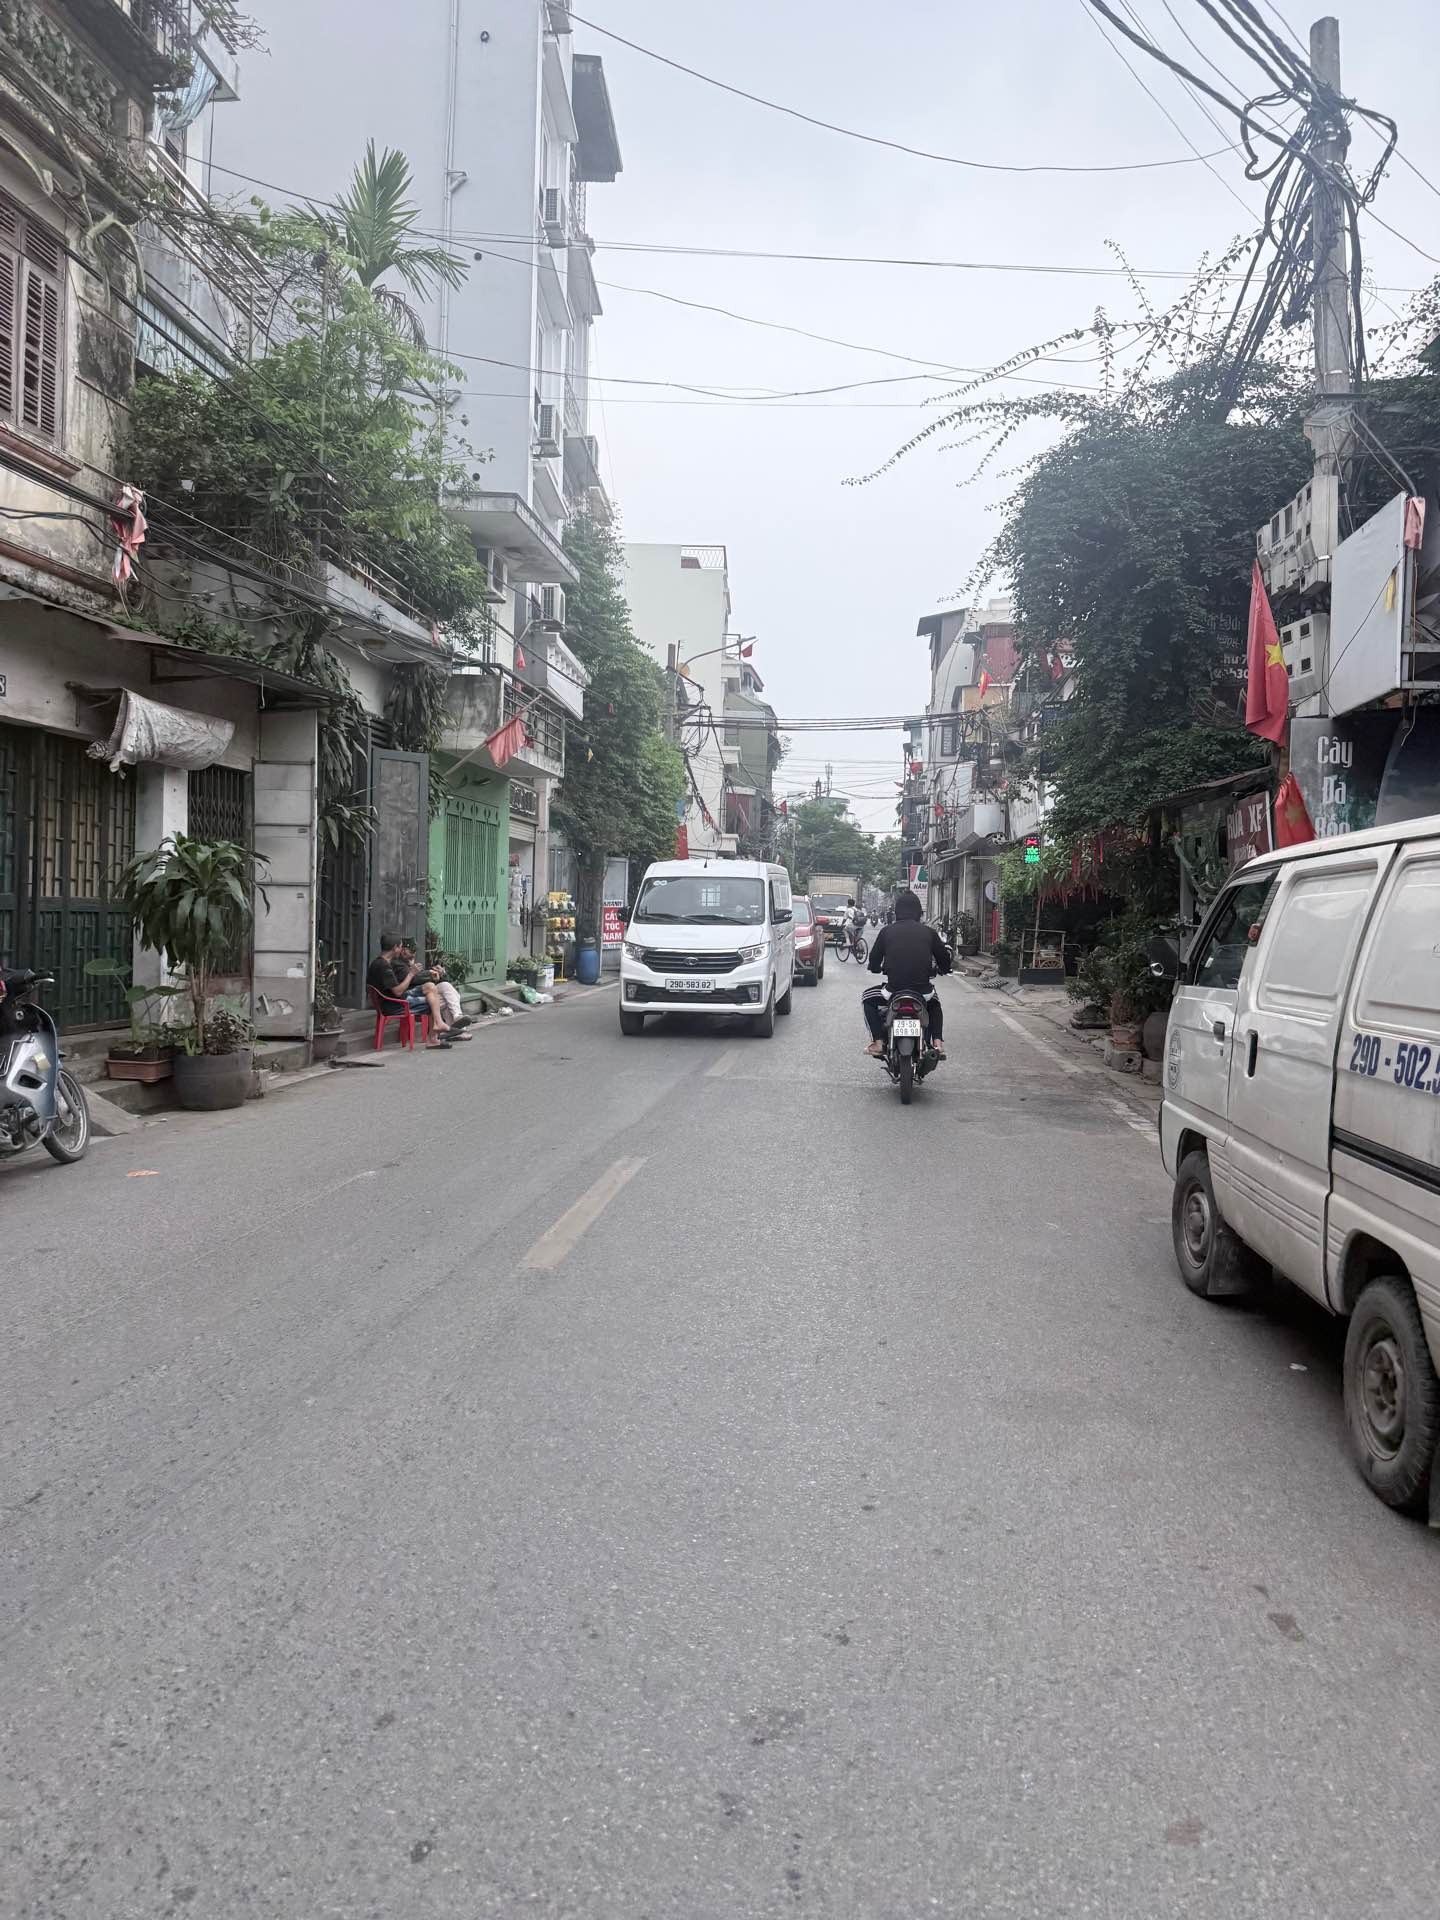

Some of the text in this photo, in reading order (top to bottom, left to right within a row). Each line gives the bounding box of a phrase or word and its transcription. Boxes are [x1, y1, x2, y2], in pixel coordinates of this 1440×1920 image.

[1317, 736, 1353, 768] Cây
[1248, 803, 1263, 832] XE
[603, 932, 622, 941] NAM
[1350, 1033, 1381, 1076] 29D
